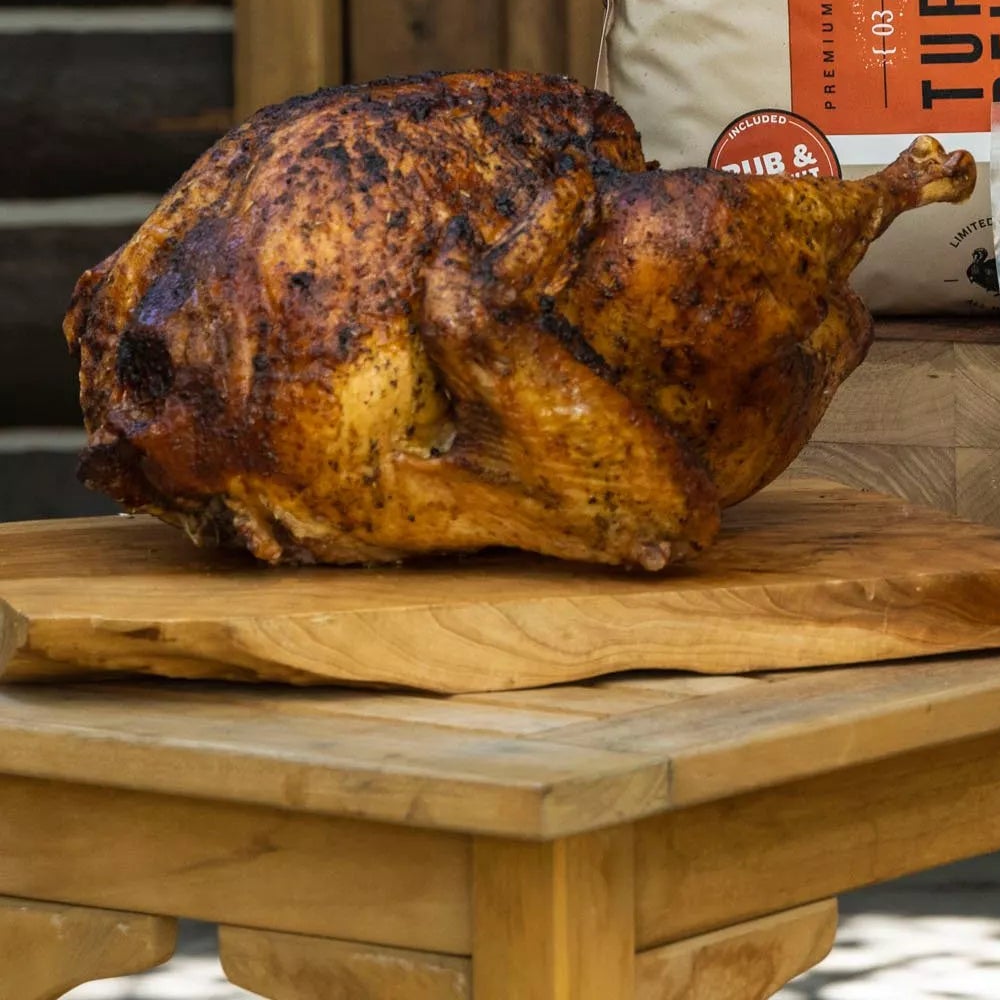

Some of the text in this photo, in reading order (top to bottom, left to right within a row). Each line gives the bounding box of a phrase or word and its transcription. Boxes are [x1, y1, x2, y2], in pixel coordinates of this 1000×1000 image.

[820, 2, 837, 109] PREMIUM
[728, 114, 787, 140] INCLUDED
[793, 143, 818, 168] &
[949, 217, 993, 249] LIMITED
